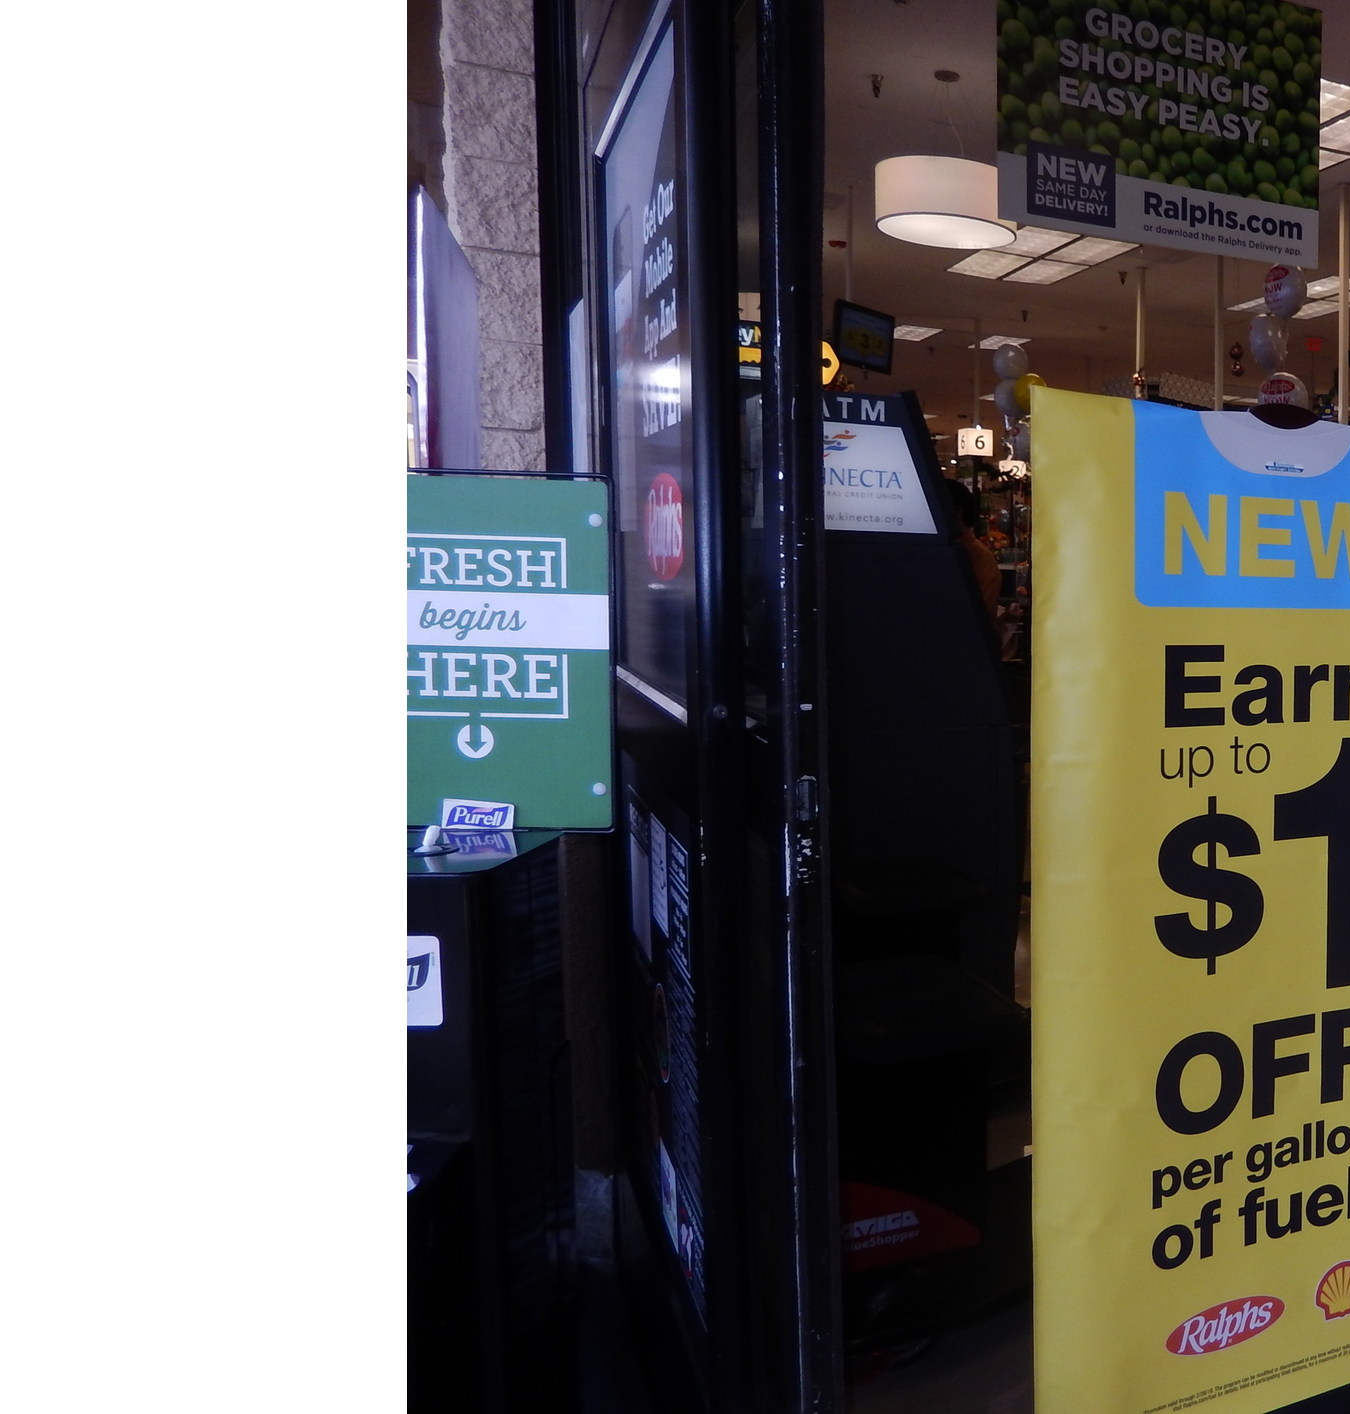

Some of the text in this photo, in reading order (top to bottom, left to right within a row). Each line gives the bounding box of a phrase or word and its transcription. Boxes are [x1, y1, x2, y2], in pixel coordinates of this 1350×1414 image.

[1085, 8, 1248, 70] GROCERY
[1059, 39, 1270, 112] SHOPPING IS
[1058, 76, 1270, 147] EASY PEASY.
[1036, 179, 1107, 202] SAME DAY
[1037, 152, 1107, 187] NEW
[643, 179, 674, 244] Get Our
[1035, 193, 1109, 217] DELIVERY!
[1144, 191, 1303, 241] Ralphs.com
[1143, 224, 1303, 256] or download the Ralphs Delivery app.
[645, 237, 674, 298] Mobile
[644, 288, 677, 361] App And
[975, 435, 985, 450] 6
[419, 601, 527, 641] begins
[1160, 736, 1271, 788] up to
[453, 806, 504, 827] Purell
[1151, 1151, 1233, 1209] per
[1151, 1204, 1221, 1270] of
[1177, 1302, 1273, 1354] Ralphs
[1223, 1379, 1240, 1389] program
